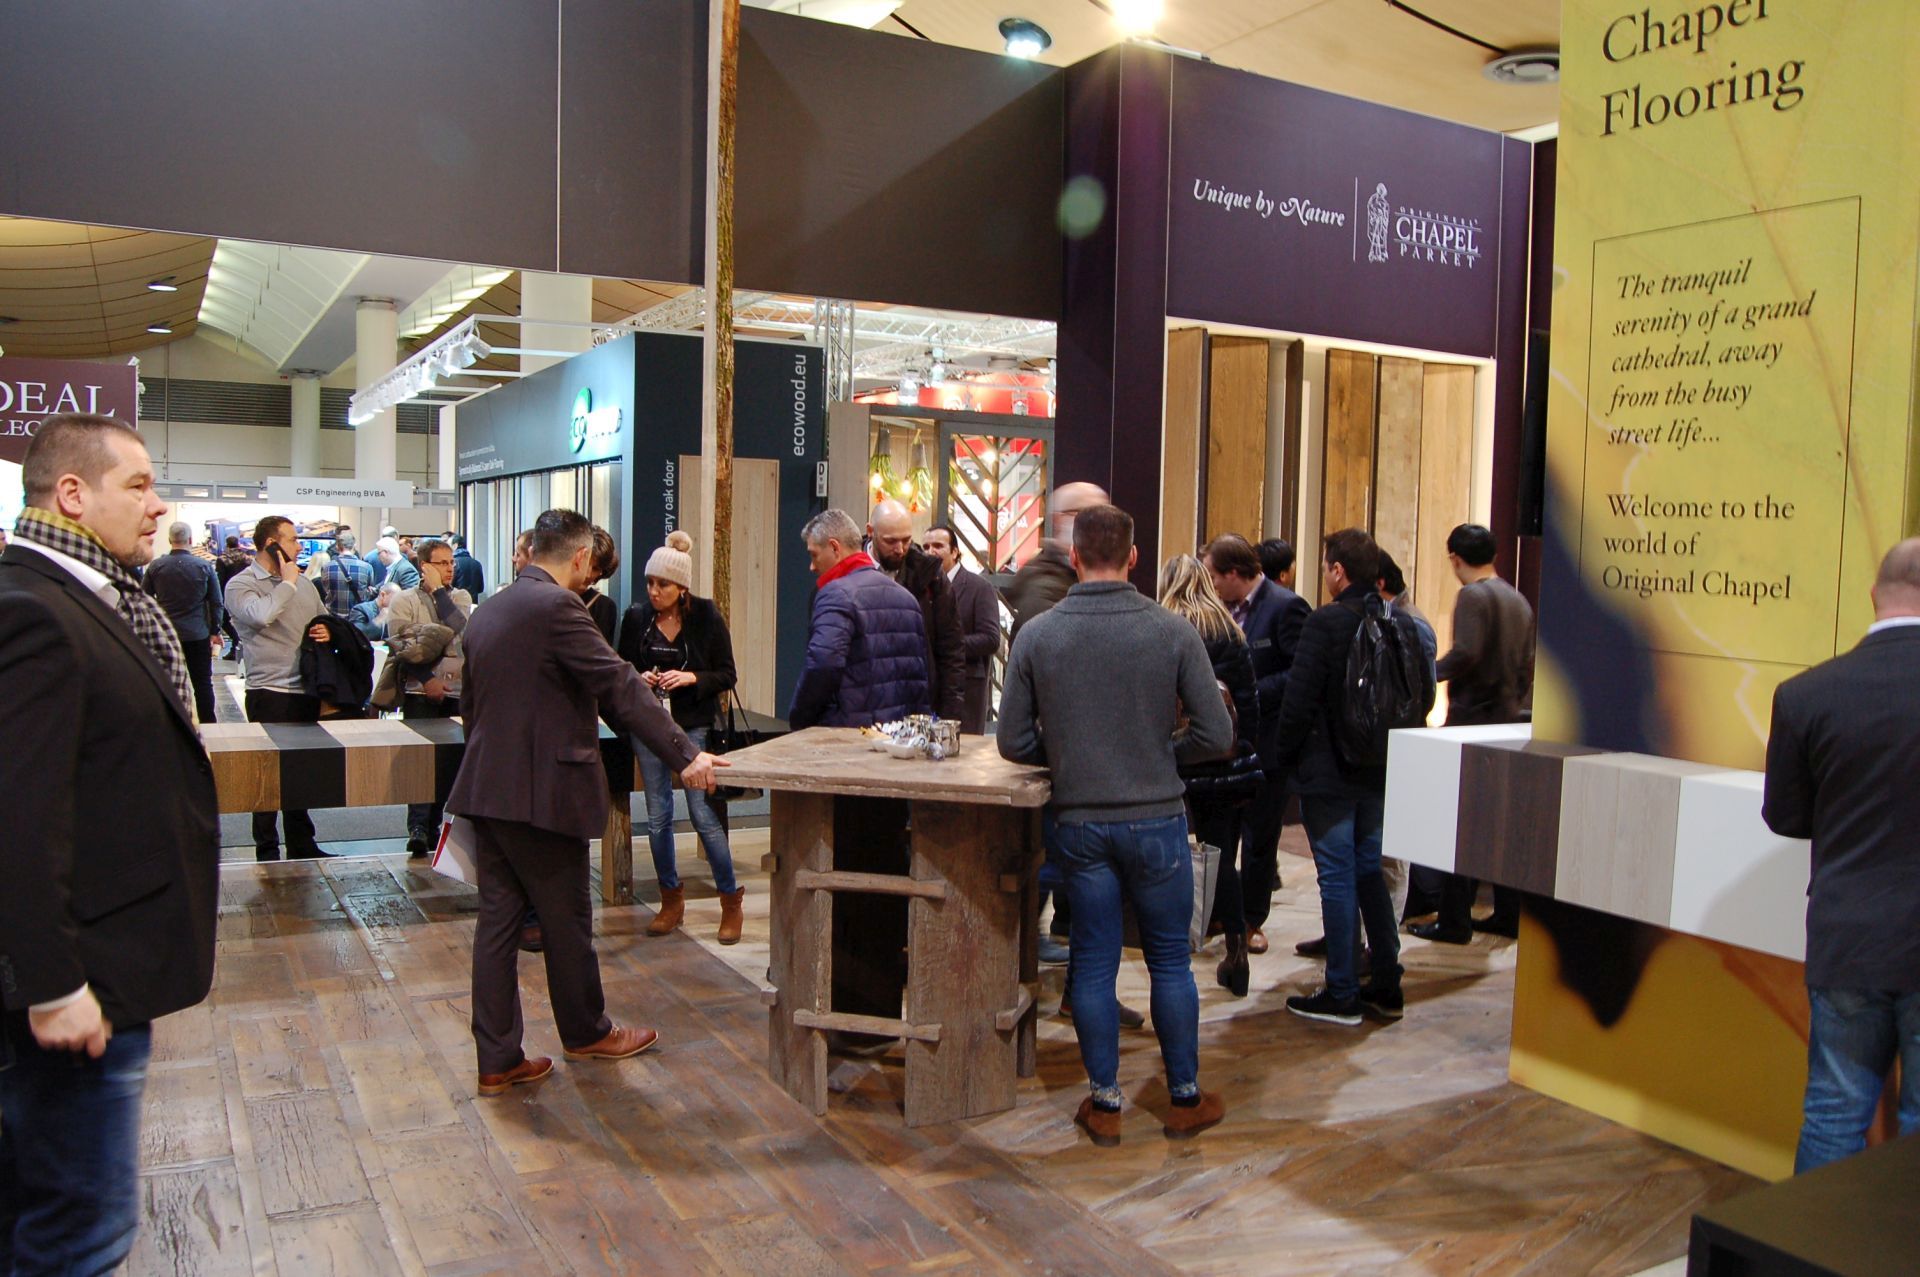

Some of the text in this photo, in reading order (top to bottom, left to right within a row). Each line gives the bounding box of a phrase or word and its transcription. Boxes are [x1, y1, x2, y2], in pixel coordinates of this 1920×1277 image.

[1600, 59, 1806, 138] Flooring
[1193, 178, 1346, 227] Unique by Nature
[1396, 216, 1479, 254] CHAPEL
[1400, 243, 1475, 269] PARKET
[1617, 257, 1752, 299] The tranquil
[1612, 288, 1817, 338] serenity of a grand
[1611, 341, 1783, 373] cathedral, away
[790, 354, 807, 457] ecowood.eu
[1604, 378, 1752, 417] from the busy
[1608, 417, 1720, 451] street life...
[662, 459, 675, 487] door
[315, 488, 361, 498] Engineering
[662, 489, 674, 511] oak
[1606, 493, 1796, 520] Welcome to the
[1603, 530, 1701, 556] world of
[1602, 565, 1792, 606] Original Chapel
